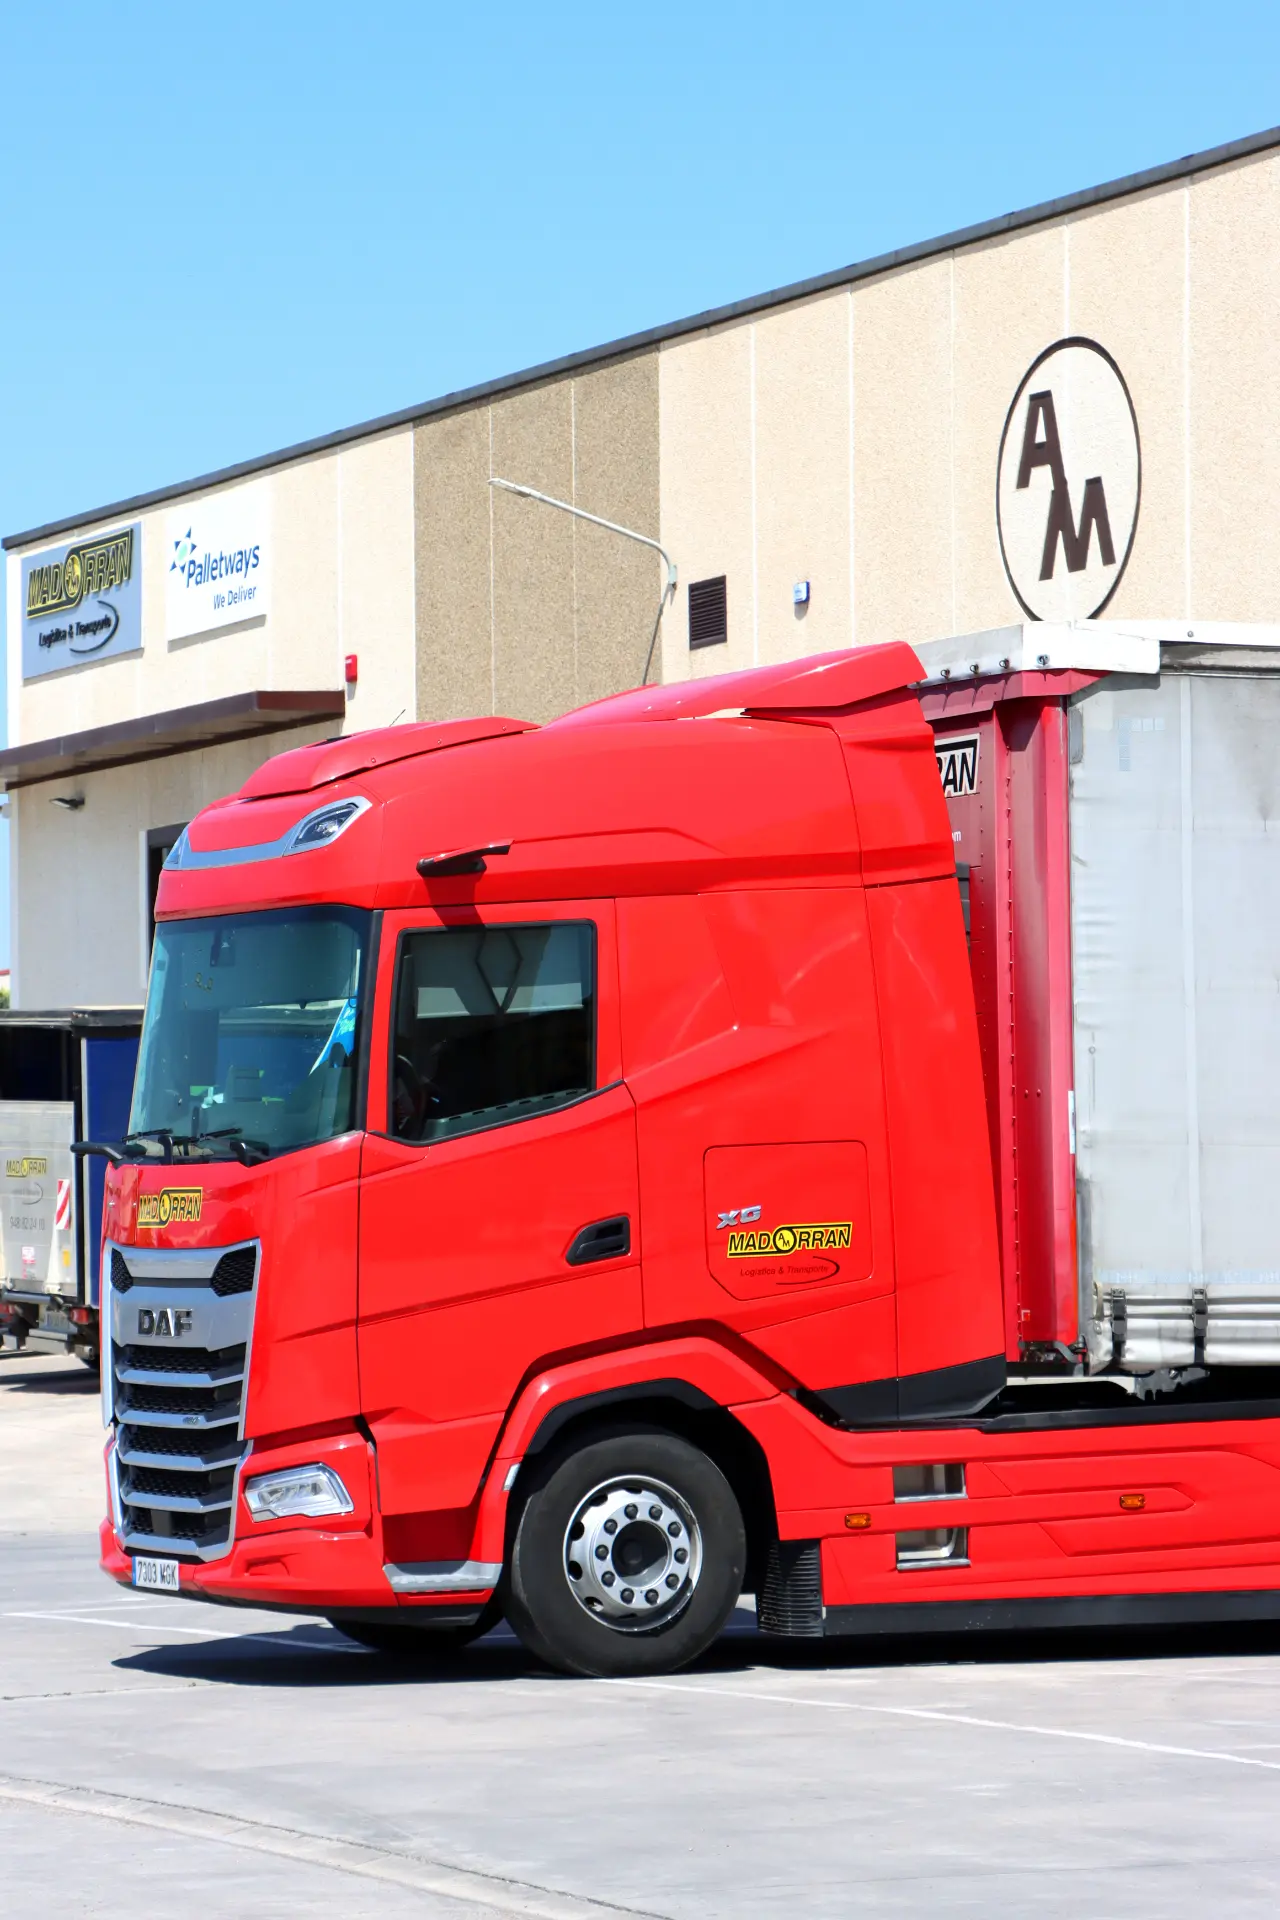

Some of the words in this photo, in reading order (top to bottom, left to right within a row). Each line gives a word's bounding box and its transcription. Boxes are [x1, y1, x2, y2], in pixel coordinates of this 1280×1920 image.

[187, 545, 260, 588] Palletways
[214, 593, 226, 610] We
[228, 585, 257, 606] Deliver
[68, 624, 73, 639] &
[137, 1188, 203, 1228] MADORRAN
[716, 1205, 761, 1229] XG
[728, 1223, 852, 1257] MADORRAN
[778, 1266, 784, 1274] &
[137, 1308, 193, 1337] DAF
[138, 1561, 157, 1584] 7303
